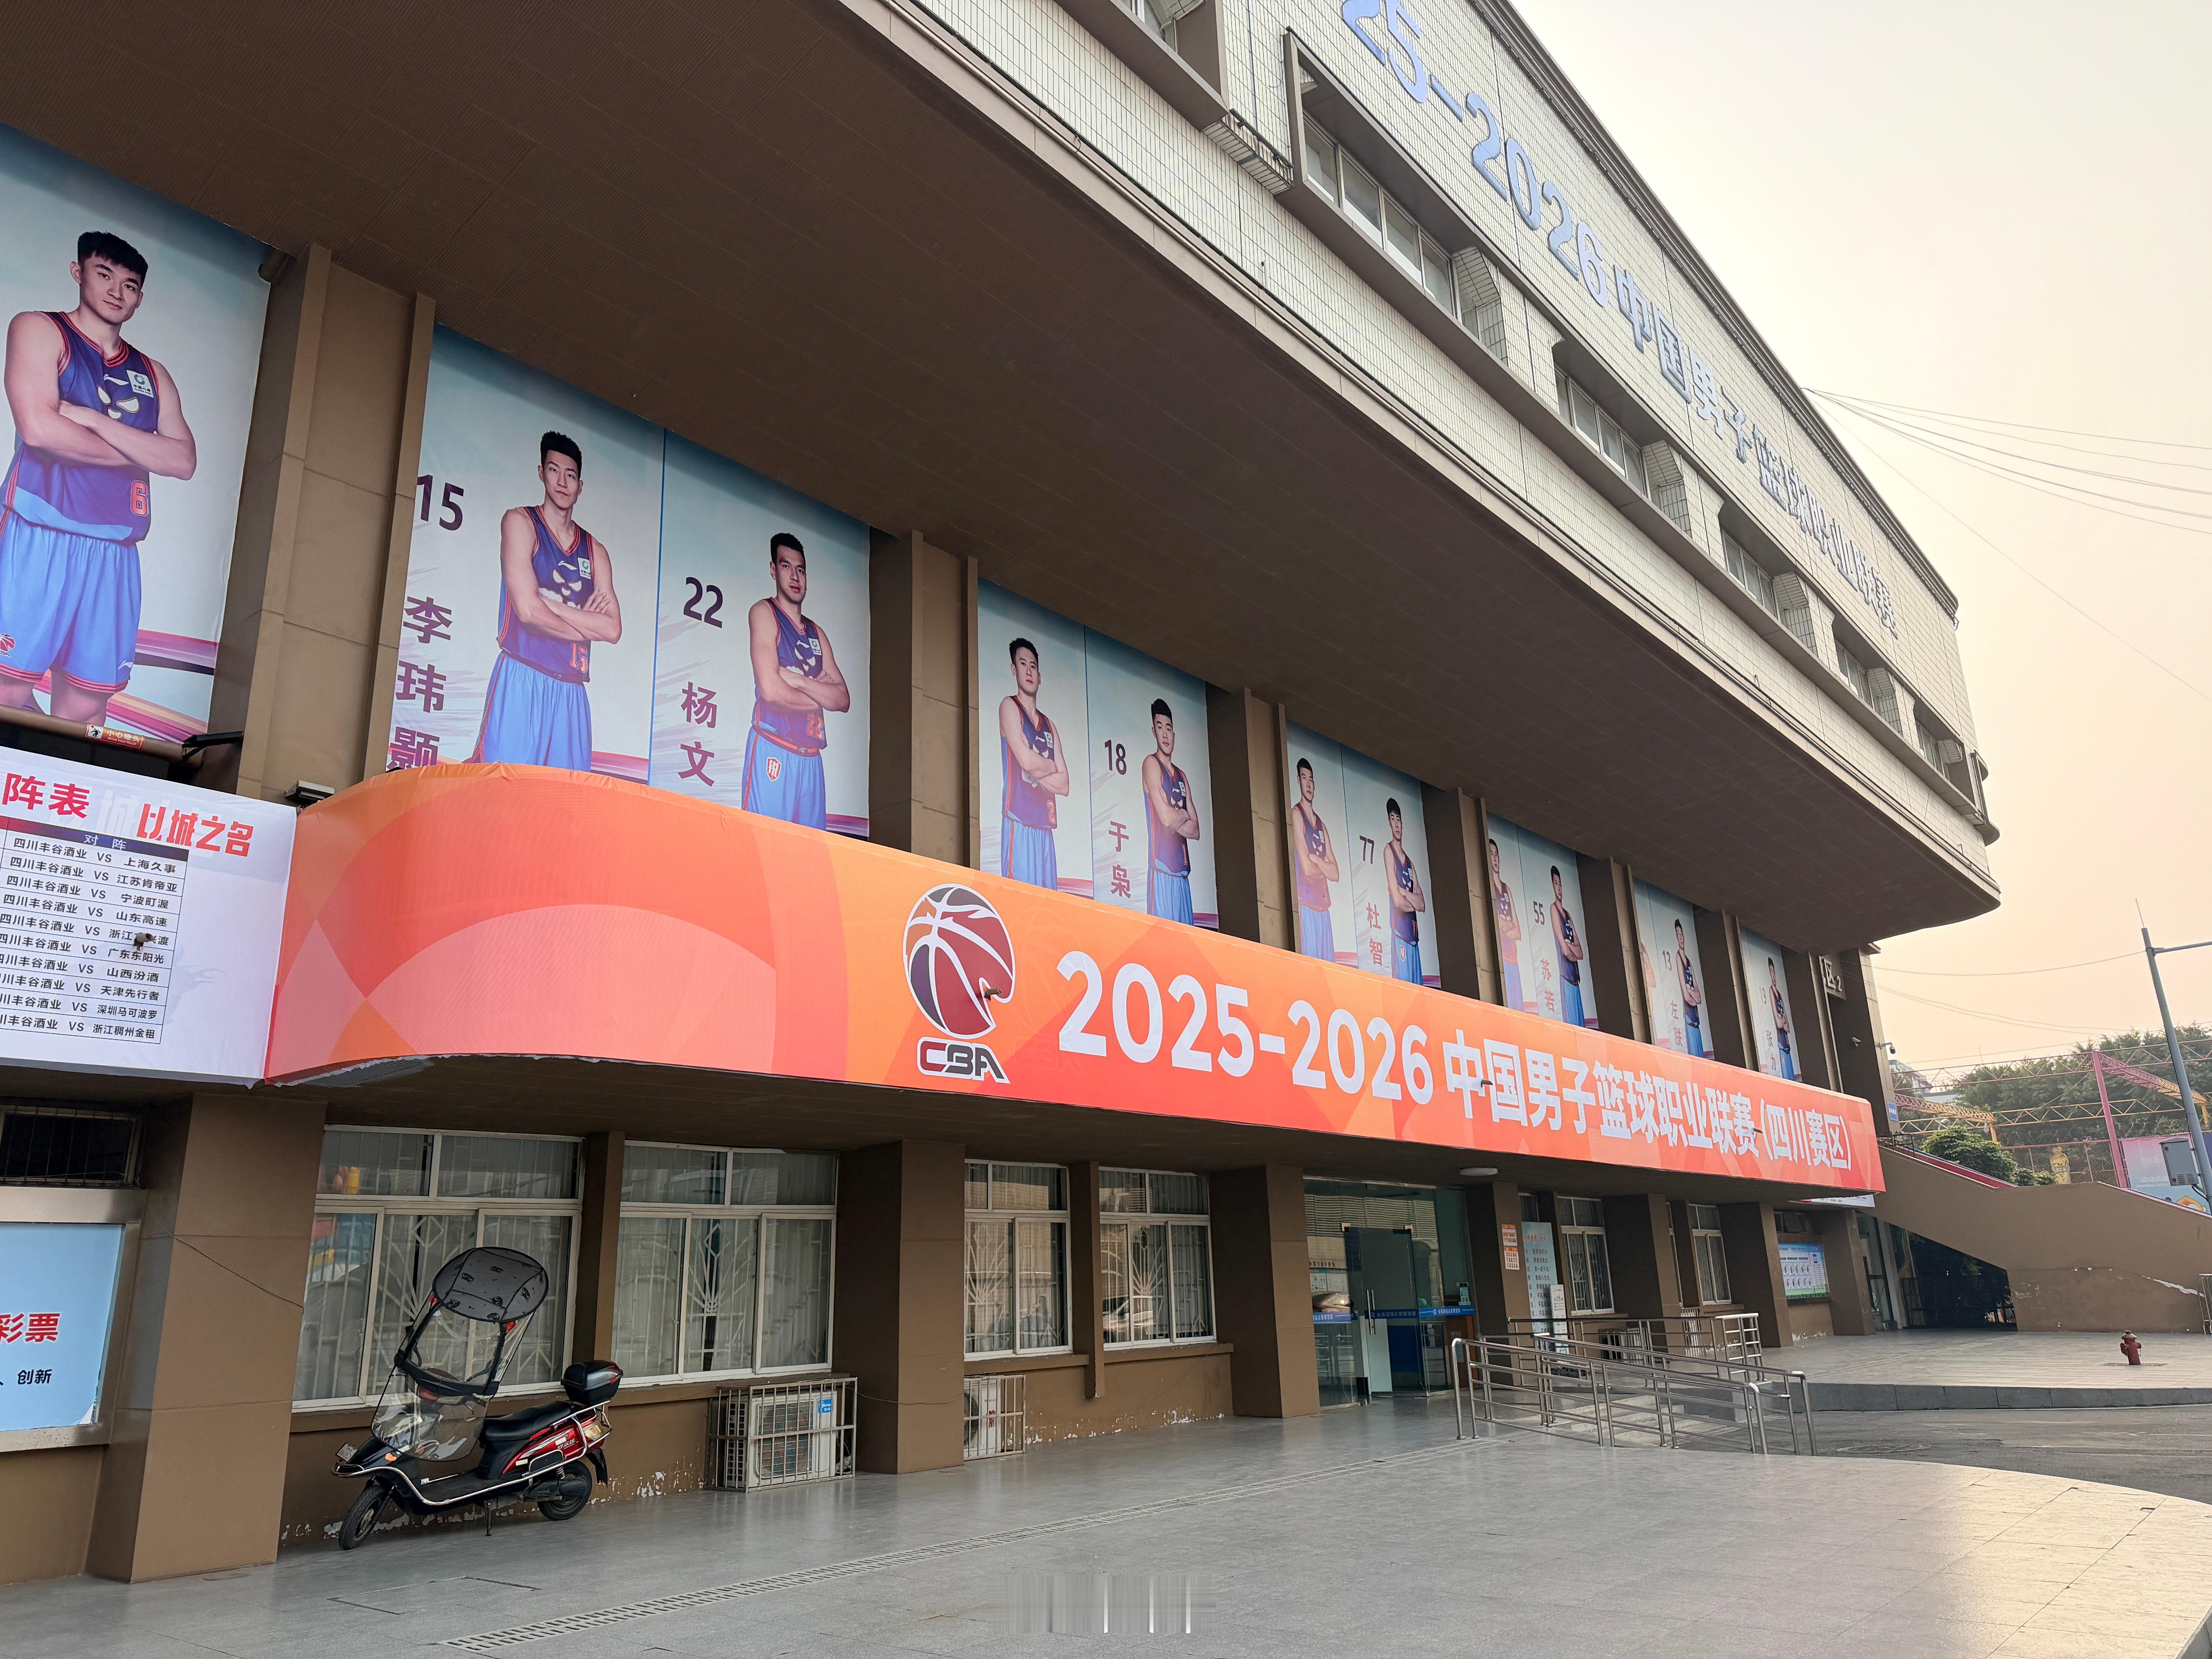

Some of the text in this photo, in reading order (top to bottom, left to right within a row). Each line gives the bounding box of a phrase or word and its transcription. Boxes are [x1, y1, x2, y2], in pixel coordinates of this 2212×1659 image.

[130, 479, 149, 517] 6
[416, 474, 464, 532] 15
[683, 576, 724, 629] 22
[570, 642, 588, 673] 15
[107, 730, 140, 742] 小心碰头
[677, 681, 718, 787] 杨文
[806, 714, 824, 740] 22
[1104, 739, 1127, 776] 18
[2, 773, 90, 819] 阵表
[136, 804, 254, 857] 以城之名
[14, 838, 177, 873] 四川丰谷酒业 VS 上海久事
[1108, 820, 1131, 899] 于枭
[1359, 835, 1374, 865] 77
[10, 857, 178, 892] 四川丰谷酒业 VS 江苏肯帝亚
[6, 875, 169, 909] 四川丰谷酒业 VS 宁波町渥
[3, 894, 167, 927] 四川丰谷酒业 VS 山东高速
[1533, 901, 1545, 926] 55
[0, 913, 169, 946] 四川丰谷酒业 VS 浙江渡
[1366, 902, 1383, 967] 杜智
[82, 944, 97, 955] VS
[108, 948, 164, 964] 广东东阳光
[1662, 950, 1672, 971] 13
[78, 963, 94, 974] VS
[107, 967, 159, 982] 山西汾酒
[75, 982, 91, 993] VS
[101, 985, 160, 1001] 天津先行者
[72, 1002, 88, 1012] VS
[97, 1004, 158, 1020] 深圳马可波罗
[1056, 950, 1434, 1105] 2025-2026
[69, 1022, 84, 1032] VS
[93, 1023, 155, 1039] 浙江稠州金租
[917, 1037, 1010, 1084] CBA
